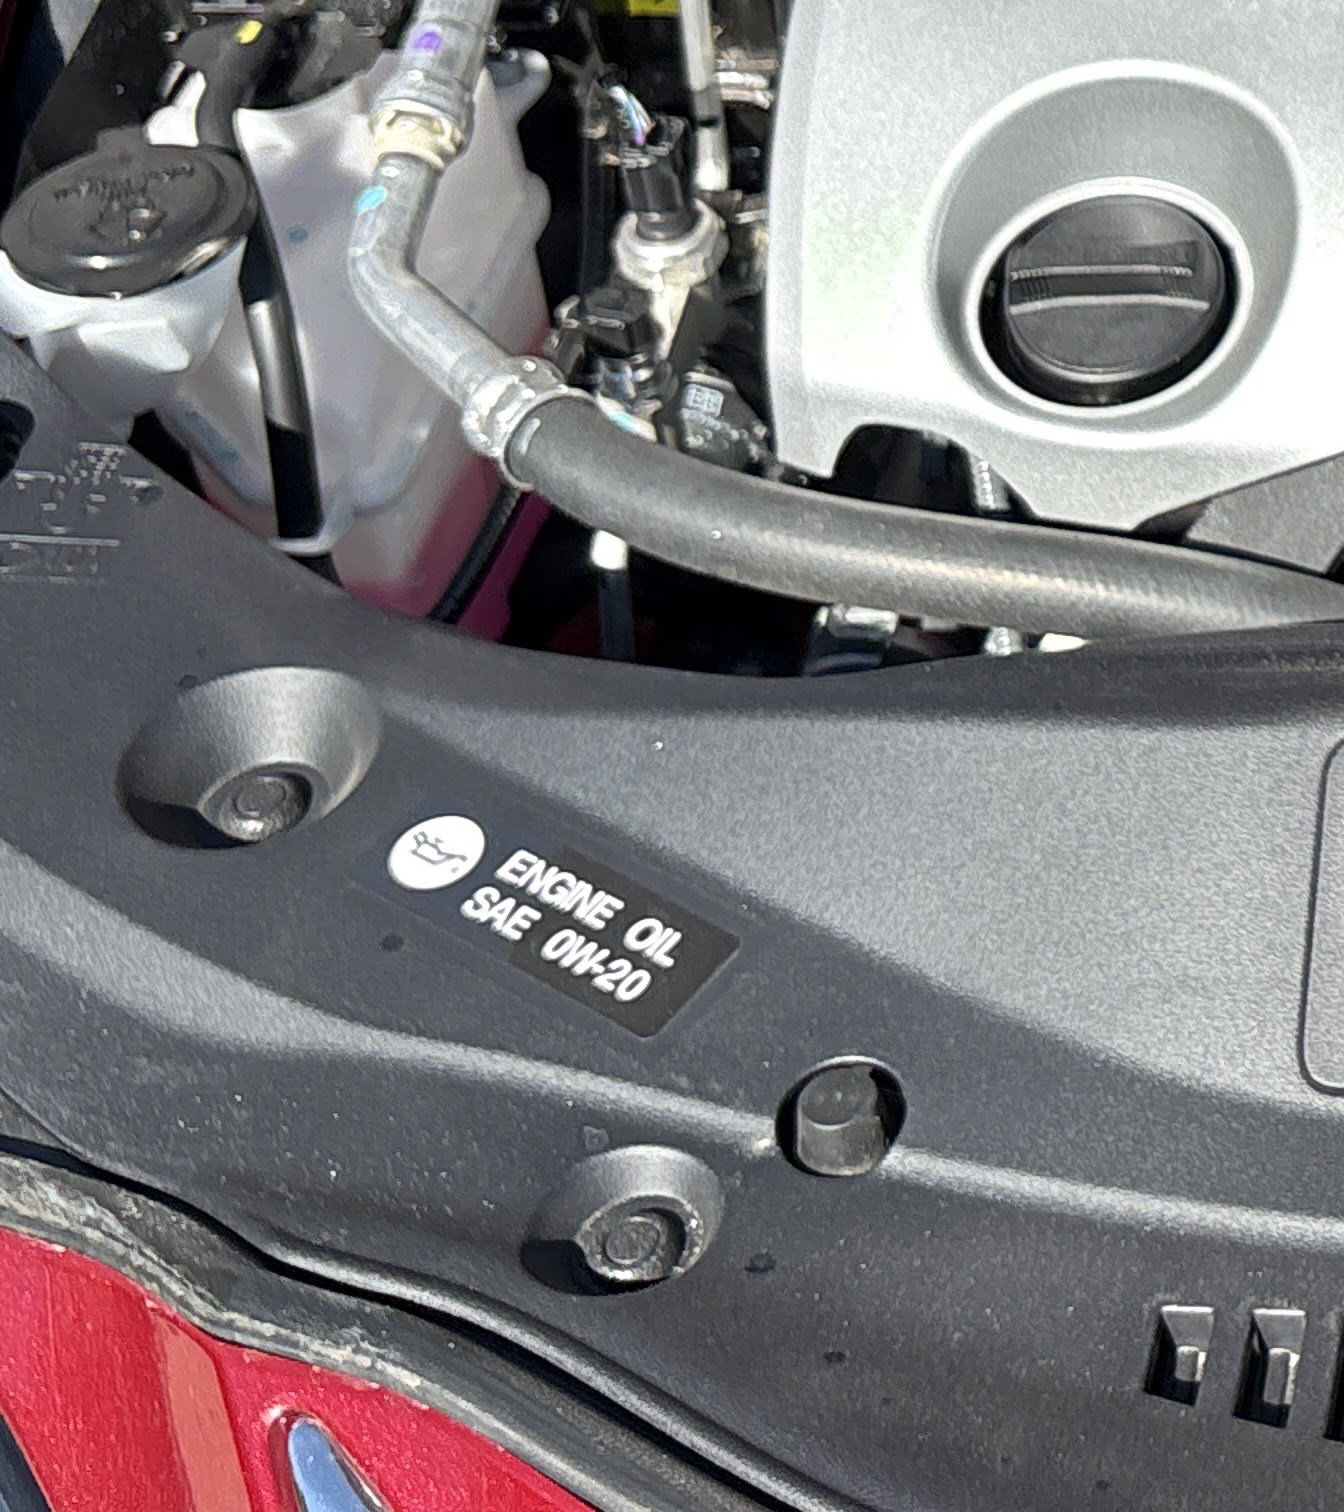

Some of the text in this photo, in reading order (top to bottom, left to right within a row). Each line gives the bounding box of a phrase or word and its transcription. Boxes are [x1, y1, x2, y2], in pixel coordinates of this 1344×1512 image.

[460, 886, 652, 1002] SAE 0W-20
[494, 849, 682, 968] ENGINE OIL
